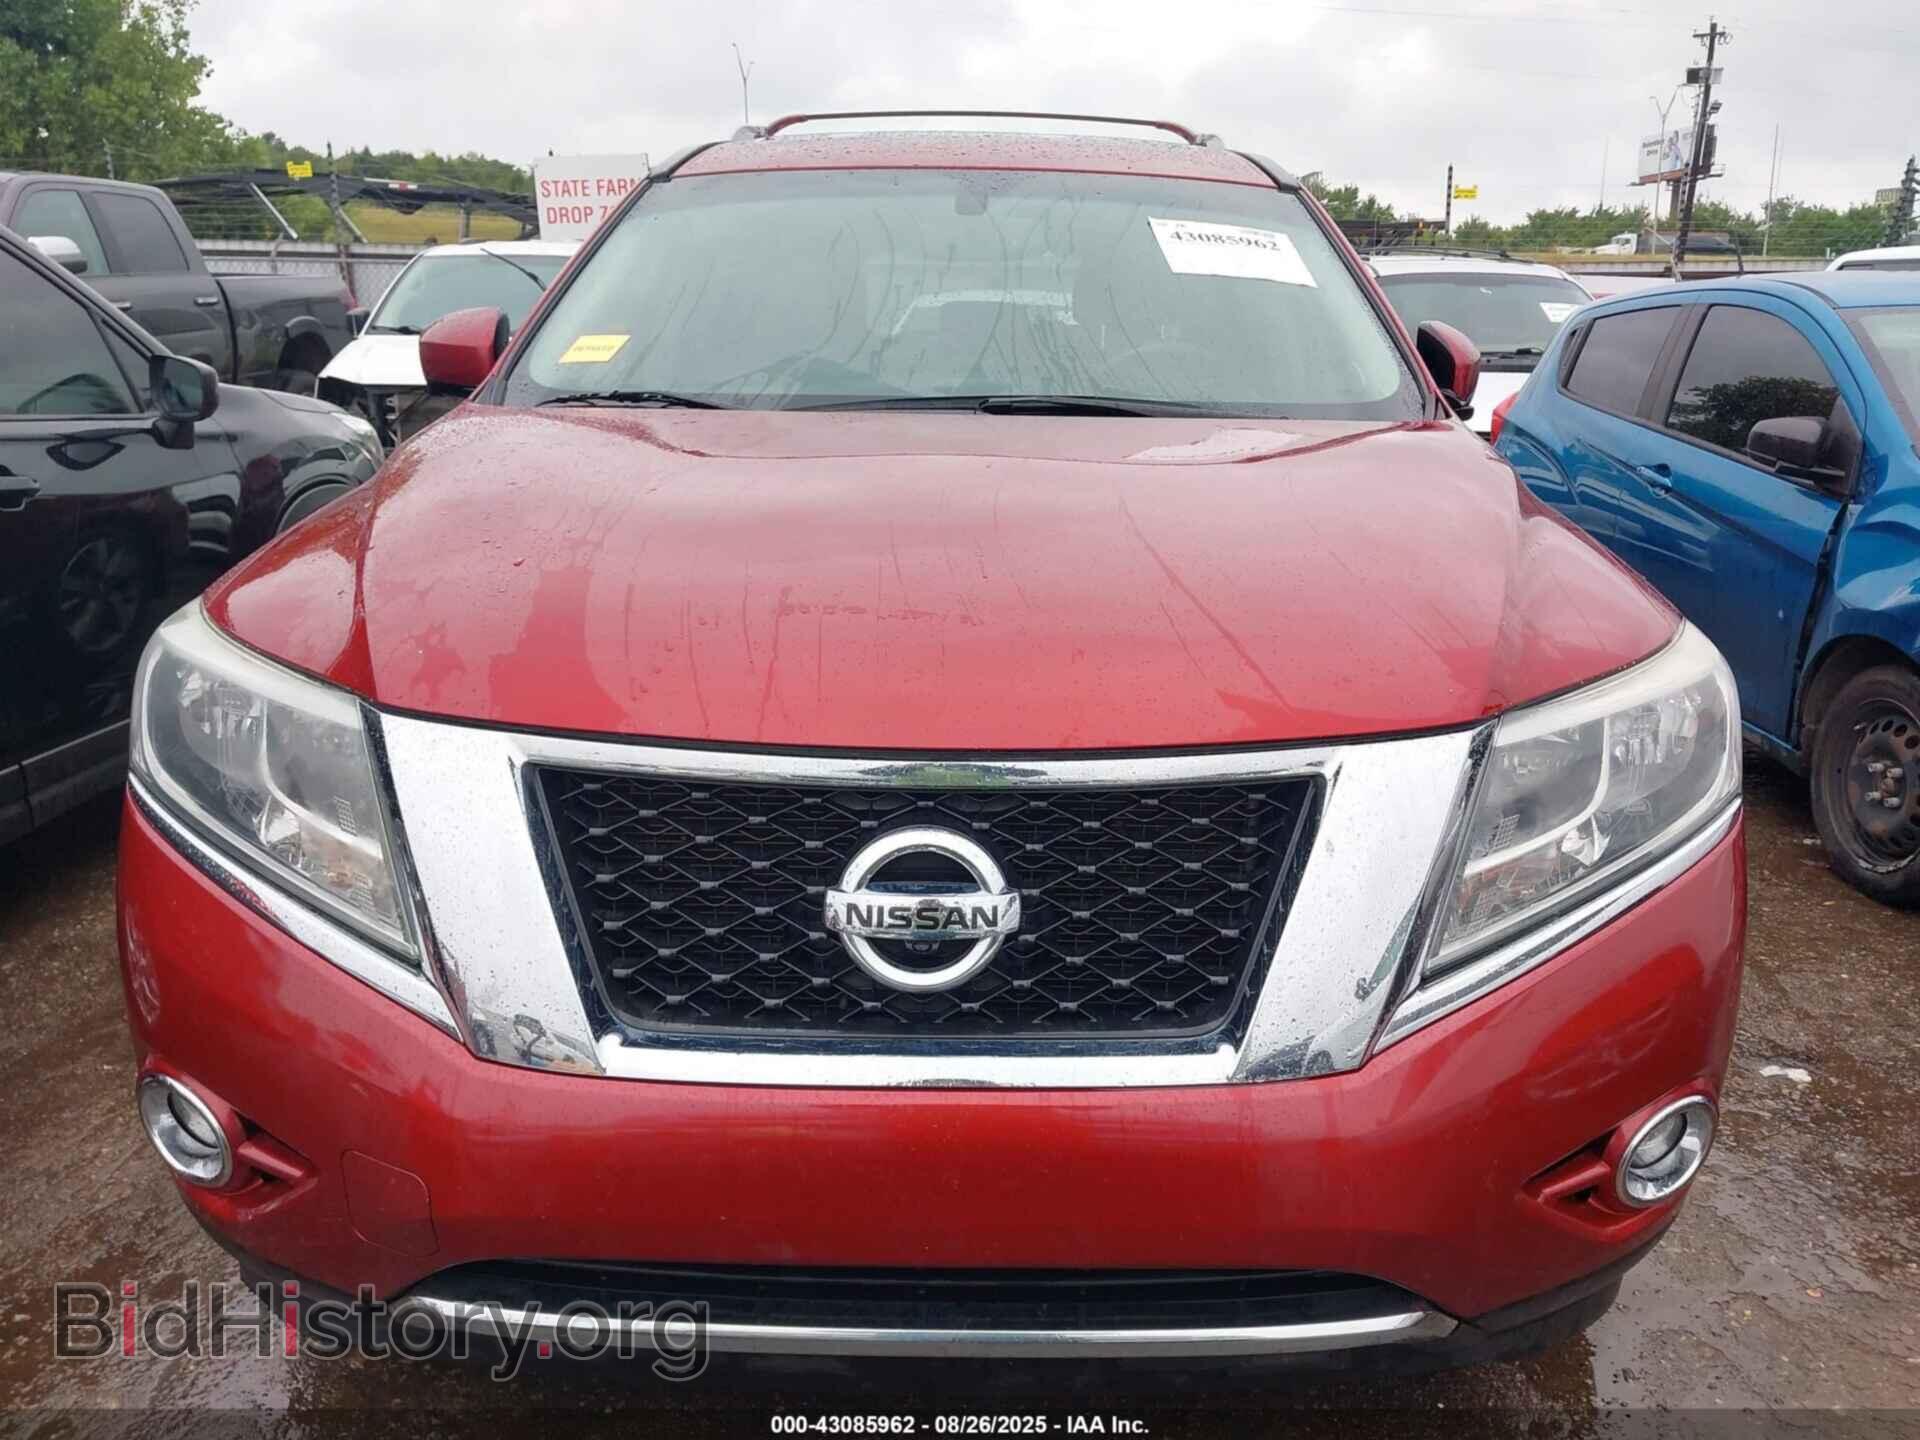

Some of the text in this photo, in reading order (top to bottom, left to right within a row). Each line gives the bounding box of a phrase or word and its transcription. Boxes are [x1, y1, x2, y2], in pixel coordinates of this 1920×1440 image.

[541, 180, 591, 198] STATE
[547, 206, 593, 225] DROP
[1170, 231, 1280, 251] 43085962
[846, 903, 998, 930] NISSAN
